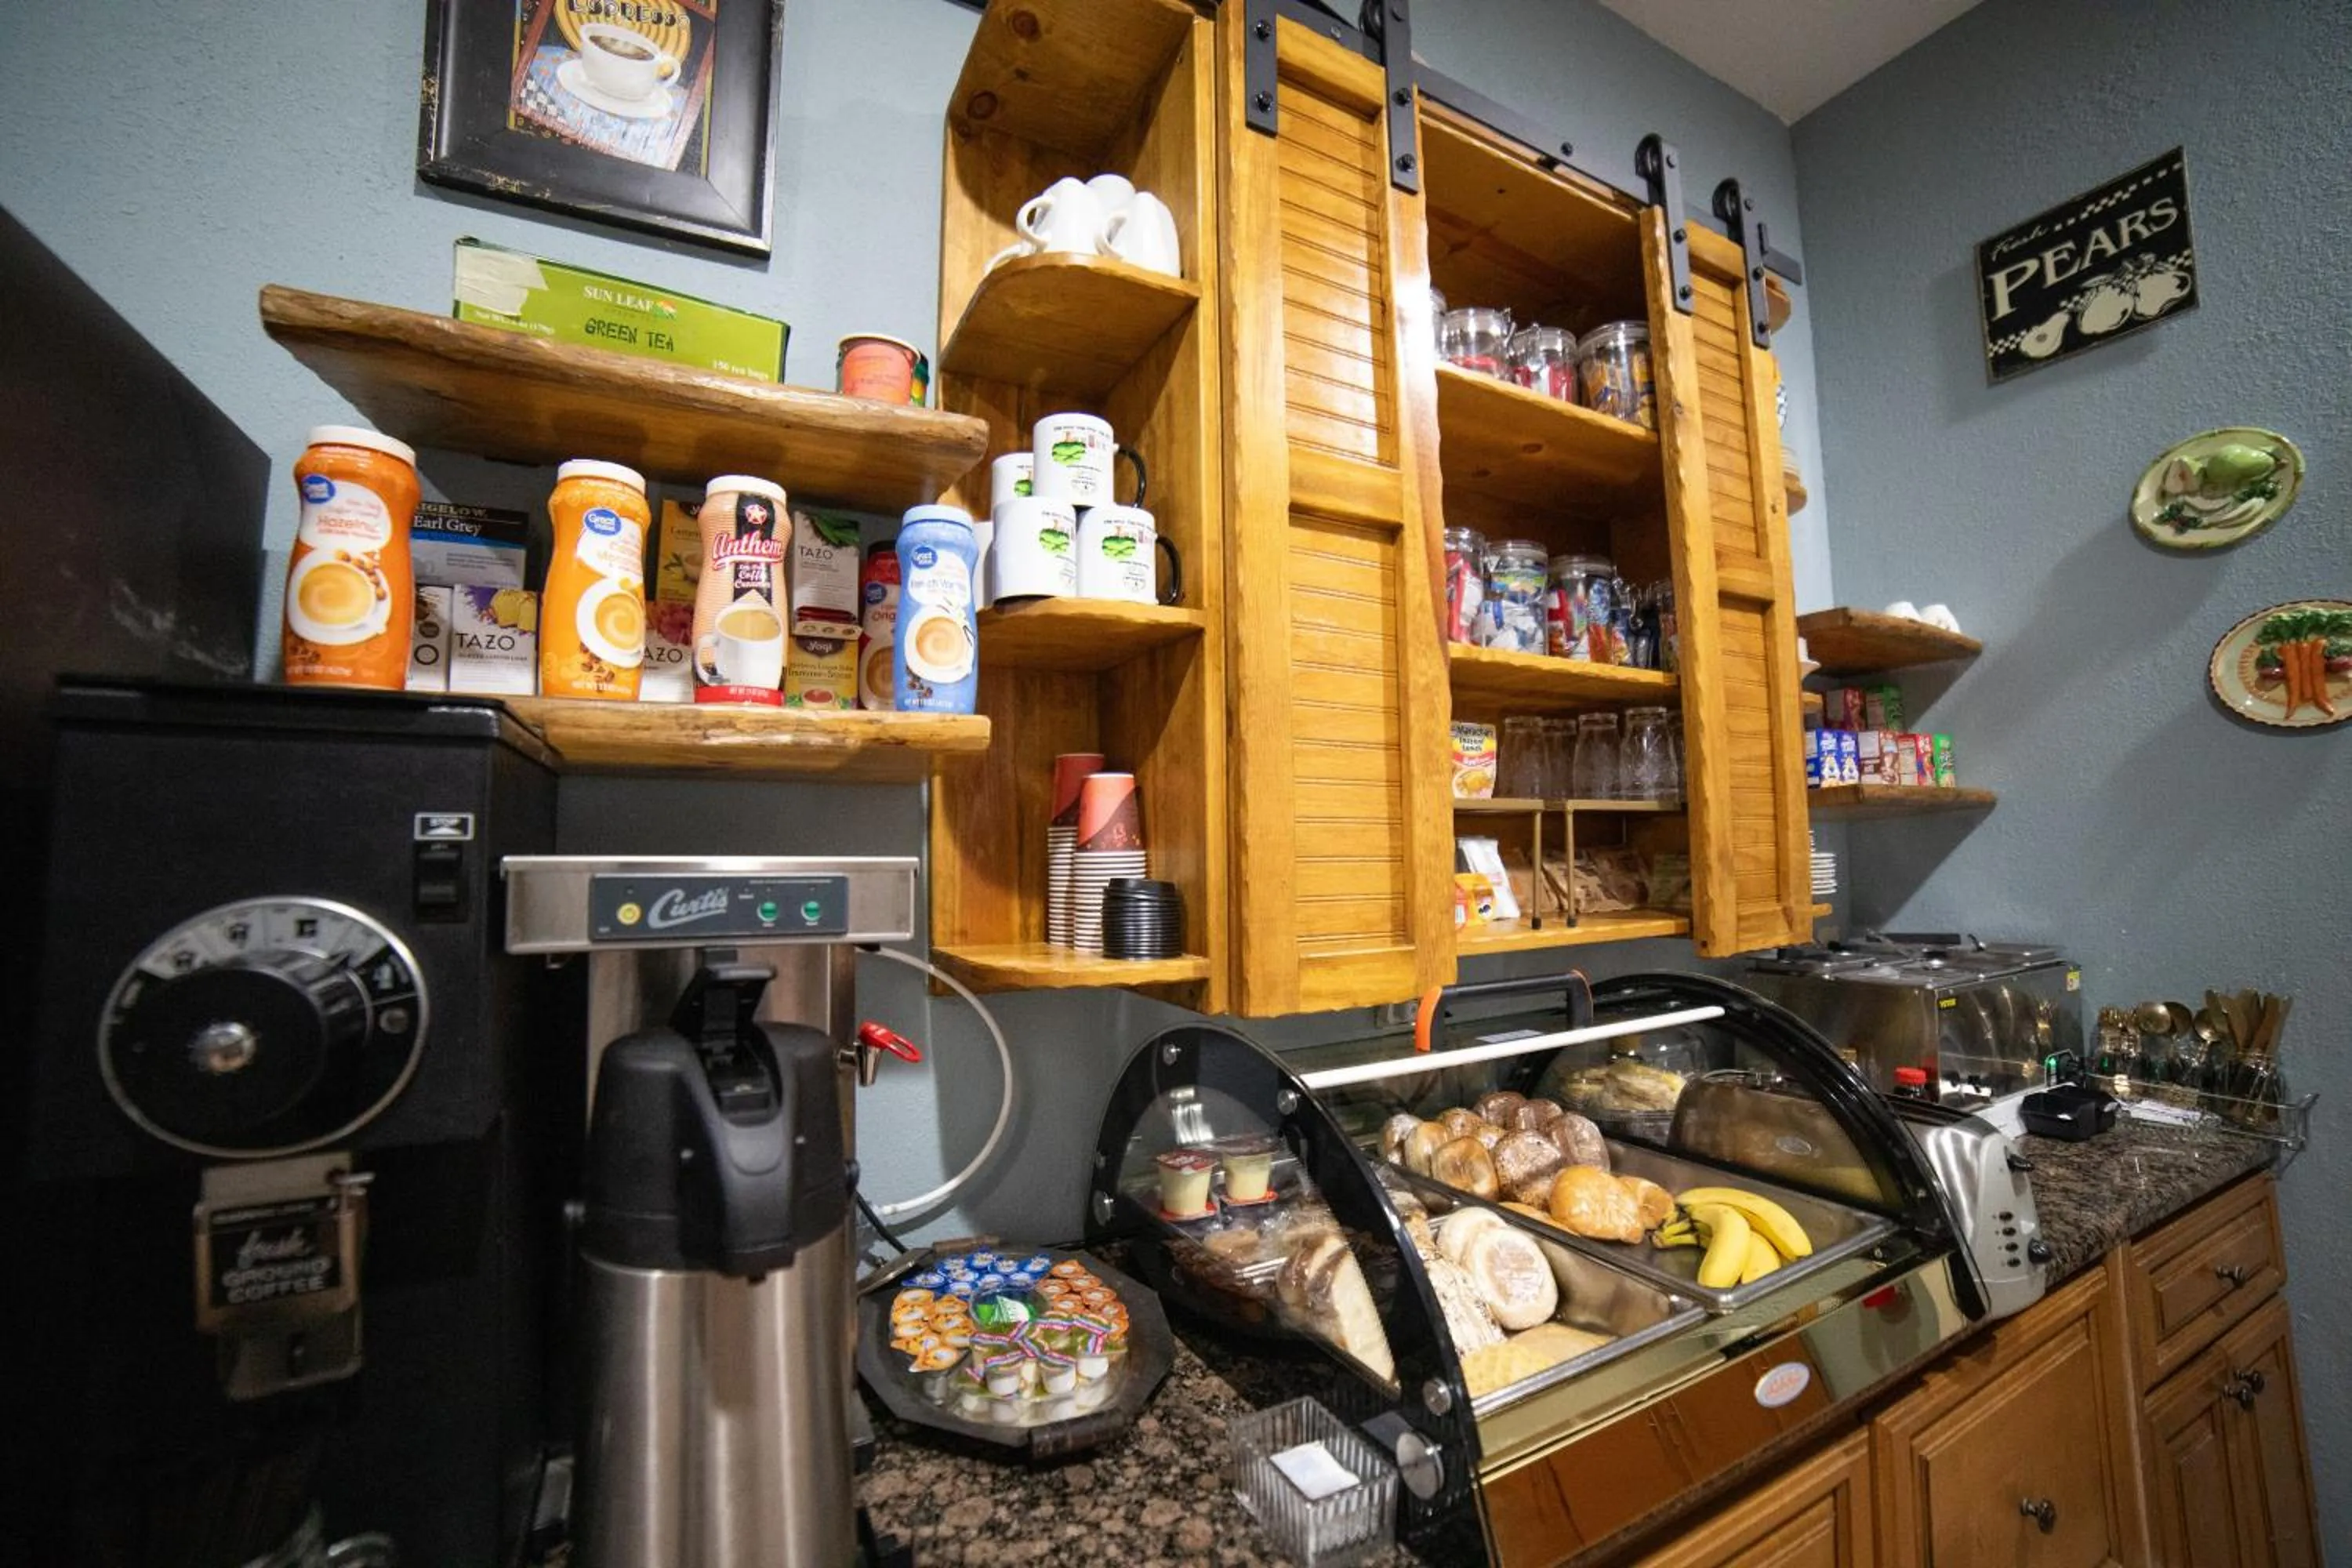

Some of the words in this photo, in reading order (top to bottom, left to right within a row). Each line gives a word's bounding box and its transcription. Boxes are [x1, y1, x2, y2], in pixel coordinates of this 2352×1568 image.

[1987, 197, 2179, 322] PEARS
[583, 285, 613, 303] SUN
[615, 292, 655, 312] LEAF
[584, 318, 638, 345] GREEN
[646, 331, 674, 352] TEA
[416, 502, 486, 517] IGELOW
[413, 514, 443, 530] Earl
[446, 518, 481, 537] Grey
[713, 530, 782, 559] Anthem
[800, 545, 834, 561] TAZO
[871, 610, 897, 622] Orig
[455, 632, 515, 652] TAZO
[806, 640, 833, 654] Yogi
[643, 648, 683, 663] AZO
[647, 886, 730, 930] Curtis
[221, 1254, 332, 1287] GROUND
[227, 1275, 326, 1304] COFFEE
